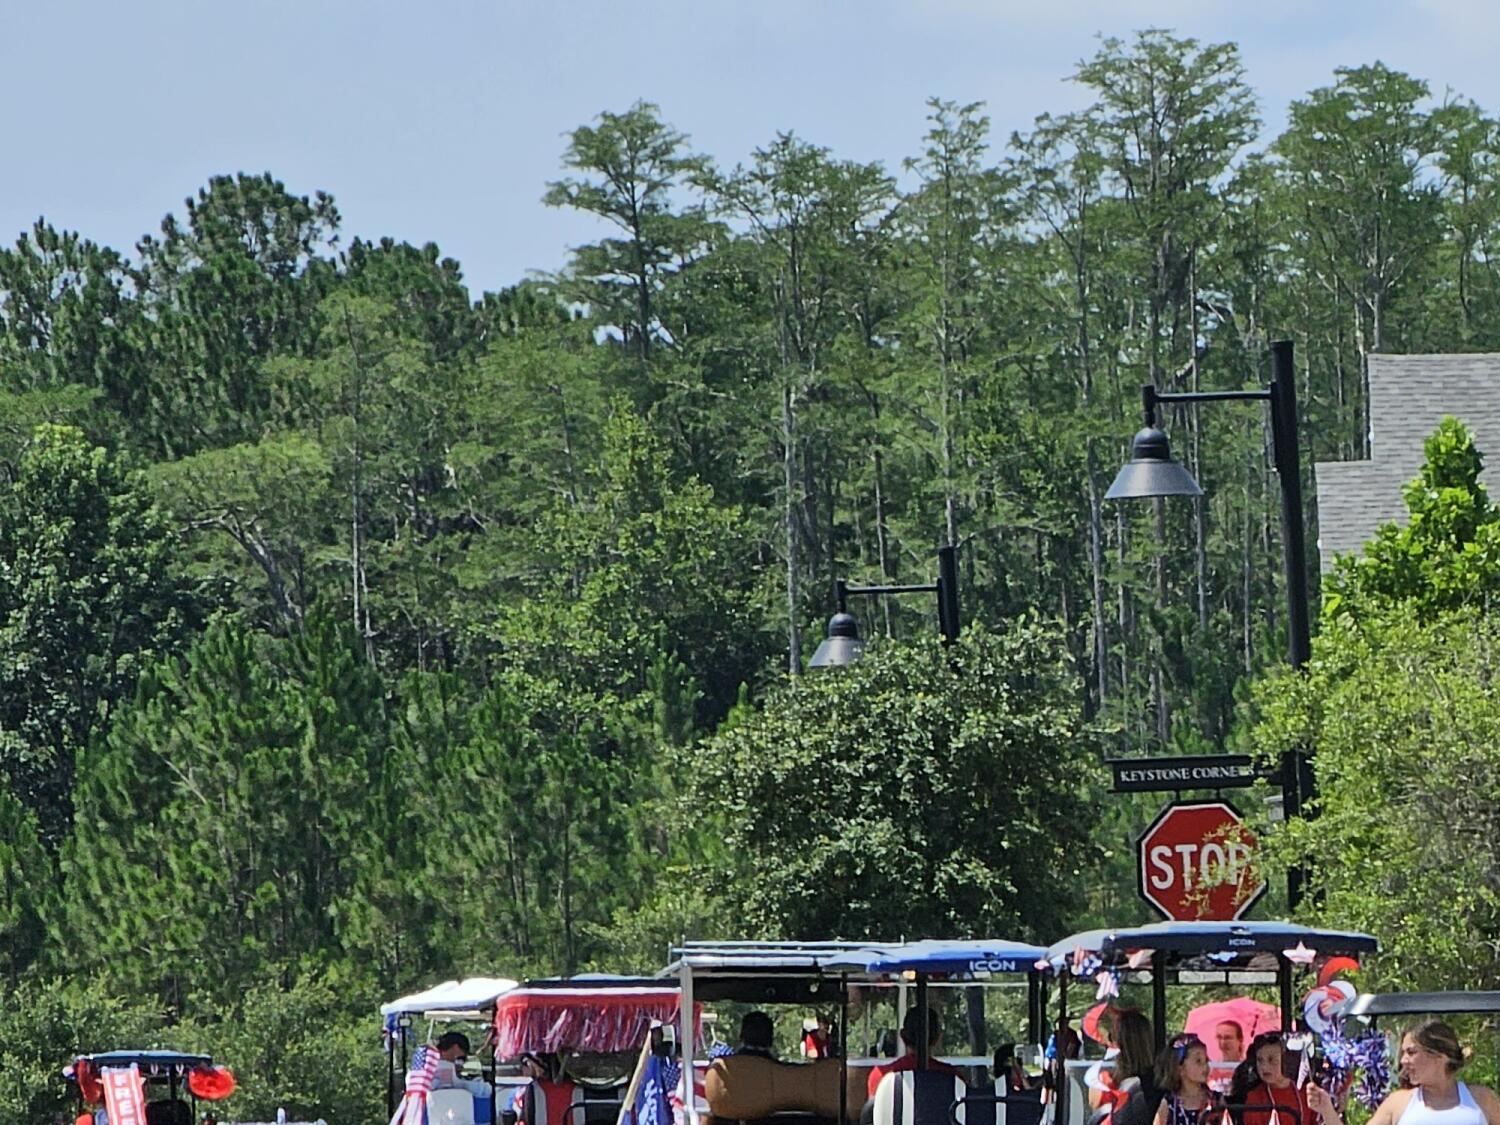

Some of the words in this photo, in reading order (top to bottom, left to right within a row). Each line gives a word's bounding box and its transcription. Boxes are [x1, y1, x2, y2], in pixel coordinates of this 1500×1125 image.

[1120, 767, 1190, 782] KEYSTONE
[1192, 764, 1255, 779] CORNES
[1150, 843, 1251, 891] STOP
[1229, 938, 1256, 946] ICON
[969, 960, 1016, 971] ICON
